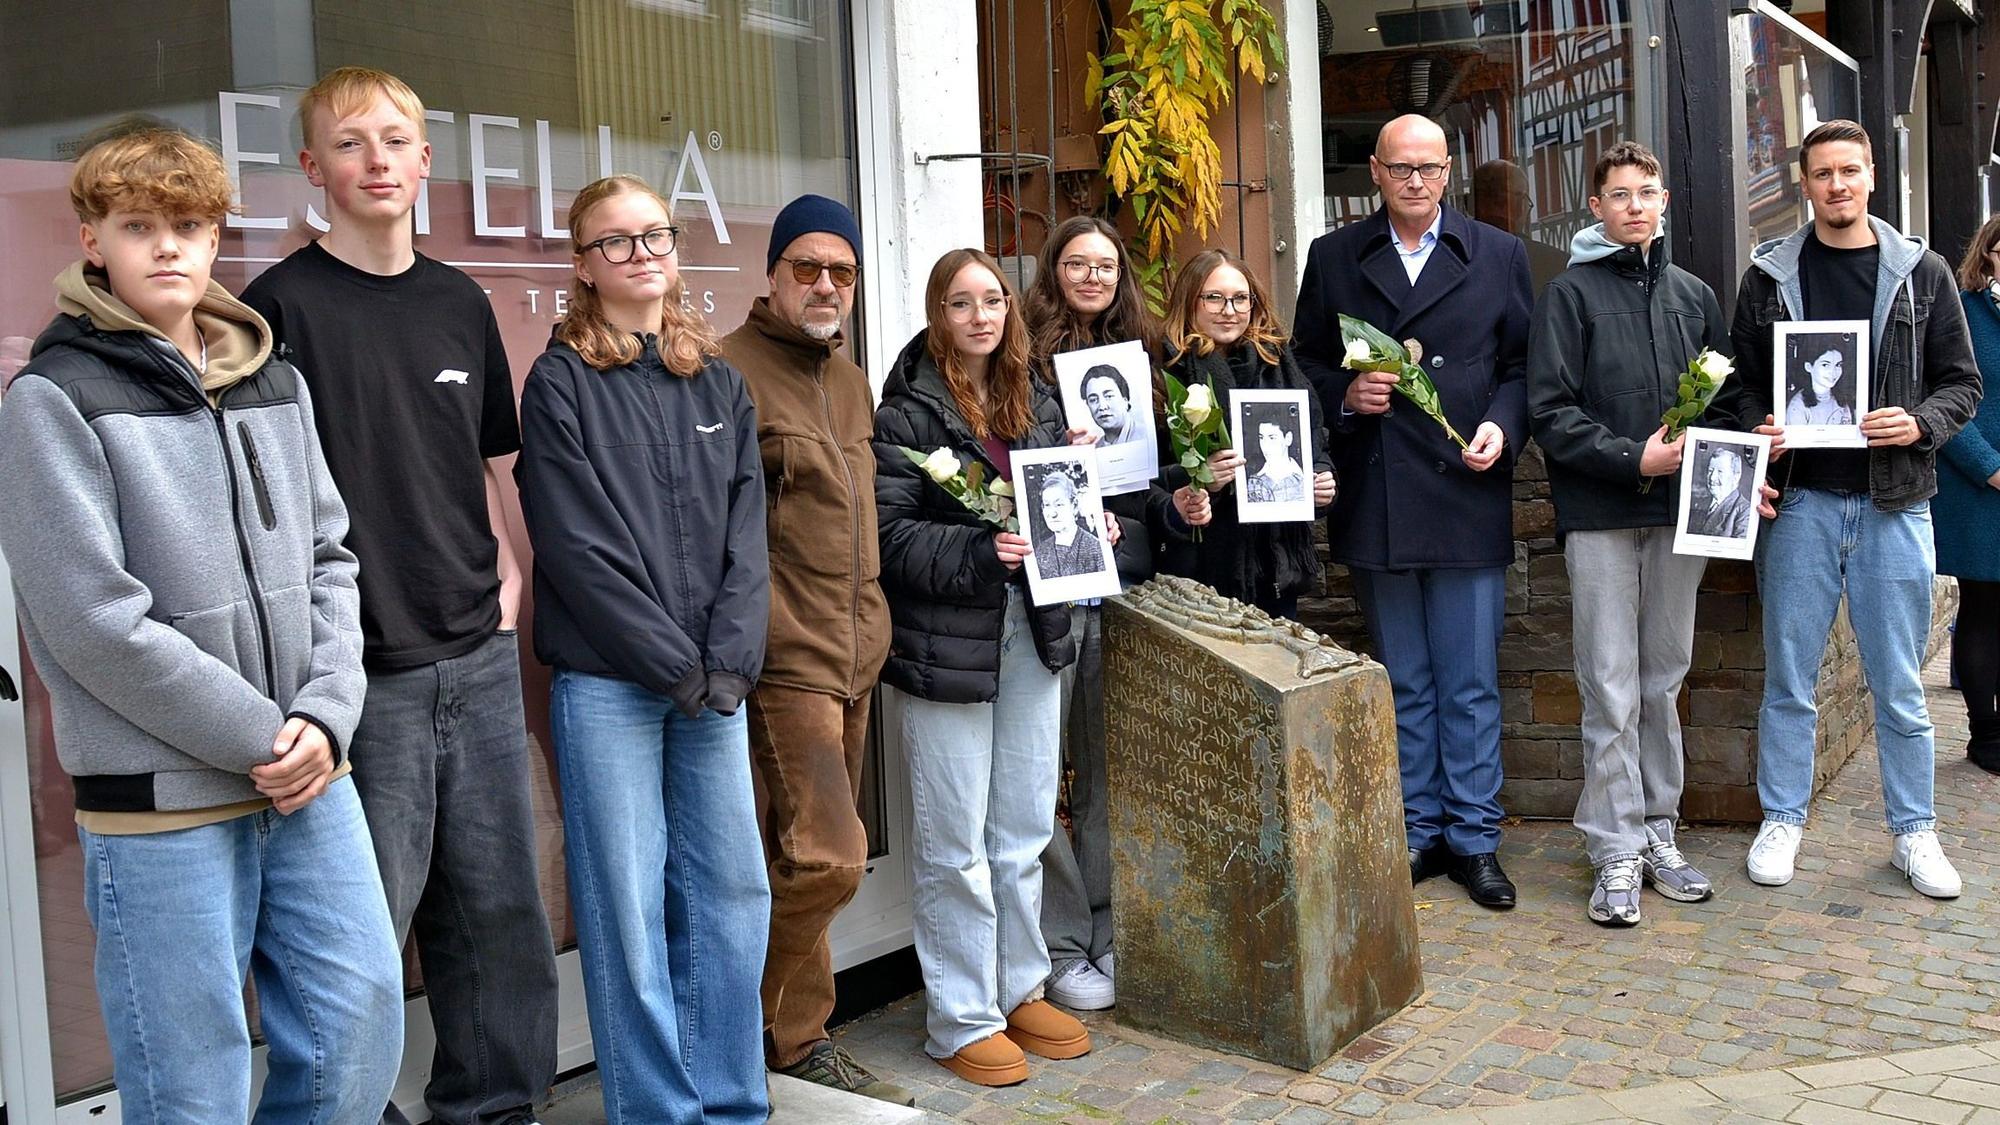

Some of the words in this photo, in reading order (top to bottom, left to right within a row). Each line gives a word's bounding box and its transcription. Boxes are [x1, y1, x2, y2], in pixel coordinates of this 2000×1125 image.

[1108, 623, 1217, 693] ERINNERUNG
[1219, 678, 1245, 706] AN
[1109, 706, 1160, 745] DURCH
